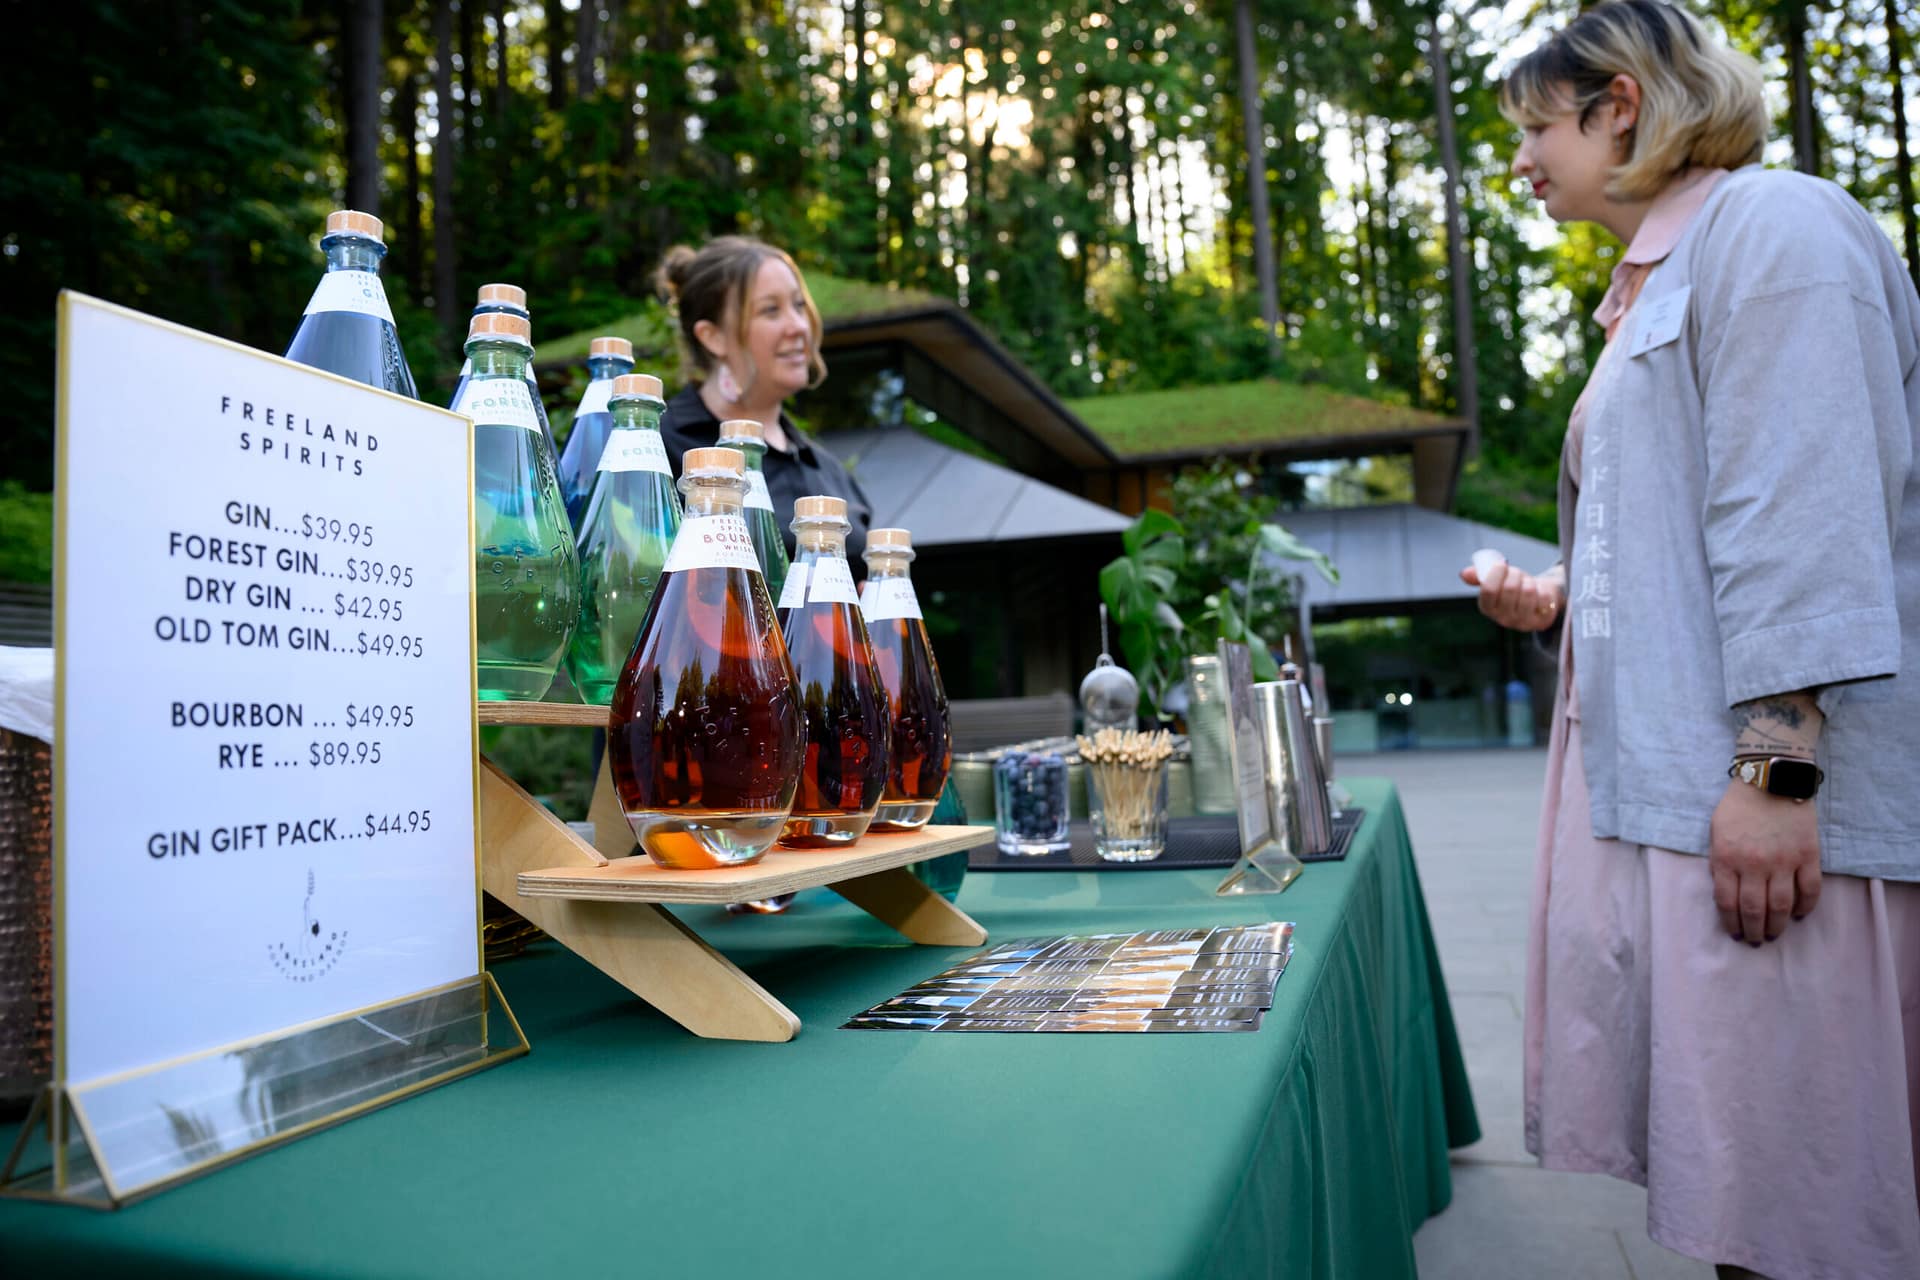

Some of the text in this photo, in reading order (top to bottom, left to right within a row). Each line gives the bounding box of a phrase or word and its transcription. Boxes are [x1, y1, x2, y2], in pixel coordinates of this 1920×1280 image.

[220, 396, 380, 452] FREELAND
[239, 432, 363, 477] SPIRITS
[169, 531, 269, 569] FOREST
[186, 576, 237, 605] DRY
[246, 583, 292, 611] GIN
[335, 592, 403, 623] $42.95
[154, 615, 212, 645] OLD
[221, 620, 280, 650] TOM
[170, 701, 303, 728] BOURBON
[345, 702, 415, 730] $49.95
[218, 743, 264, 769] RYE
[309, 741, 382, 769] $89.95
[146, 829, 202, 860] GIN
[210, 824, 269, 854] GIFT
